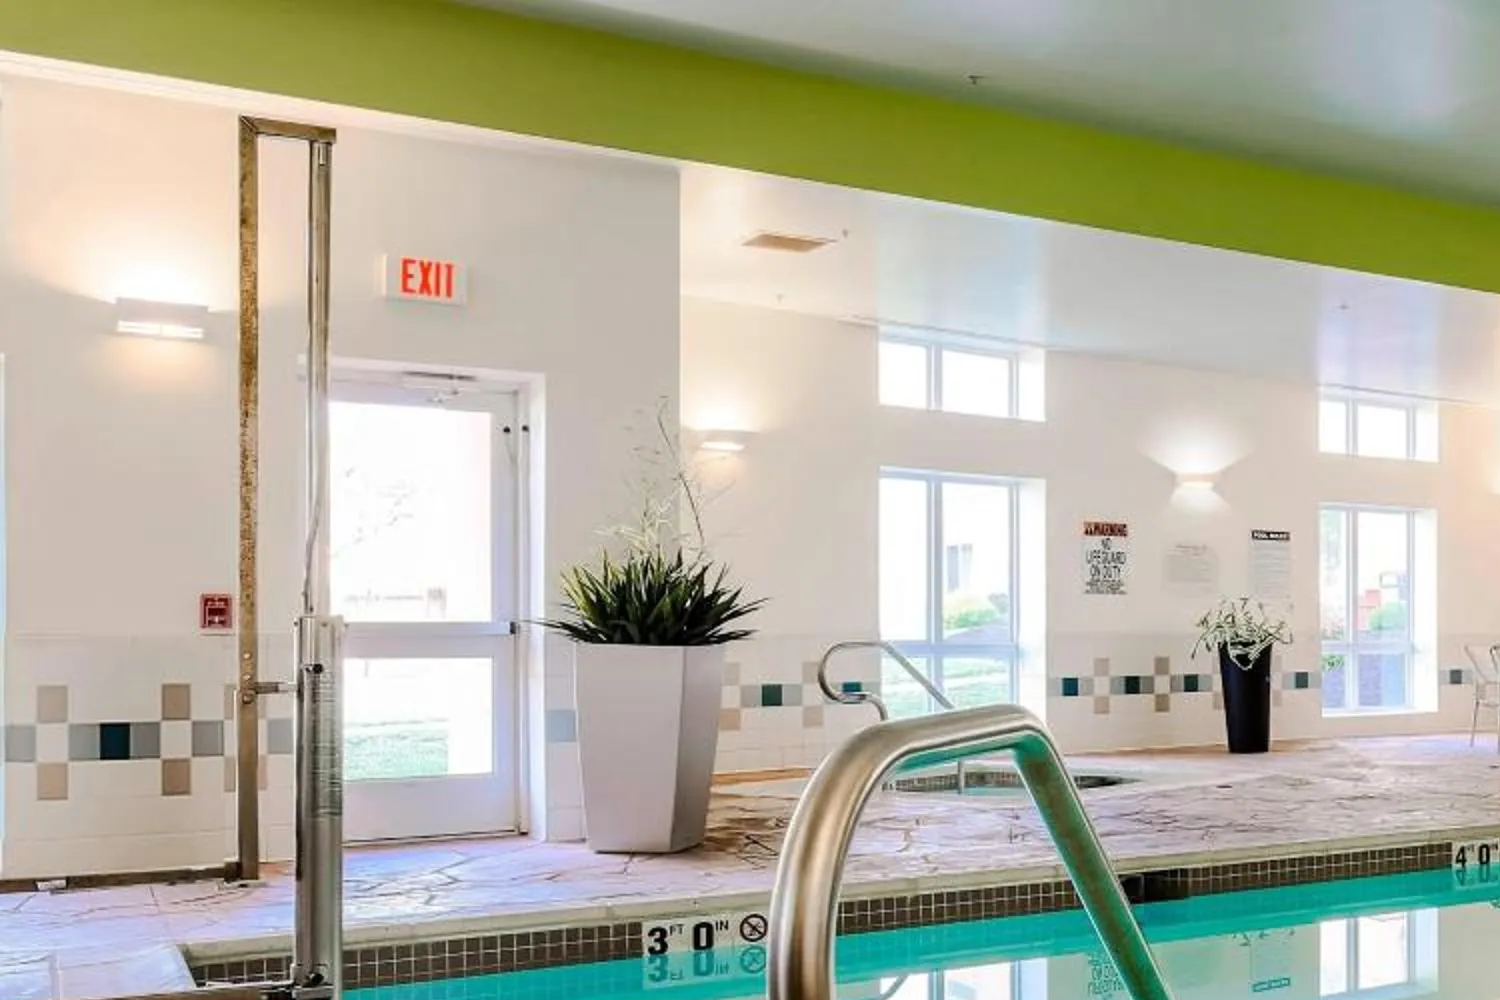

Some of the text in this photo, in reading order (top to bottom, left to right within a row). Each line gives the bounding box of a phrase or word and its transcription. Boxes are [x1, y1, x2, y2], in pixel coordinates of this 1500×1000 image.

[401, 257, 455, 298] EXIT
[1085, 549, 1127, 565] LIFEGUARD
[1455, 846, 1467, 867] 4
[1479, 844, 1490, 865] 0
[647, 920, 729, 955] 3 FT 0 IN
